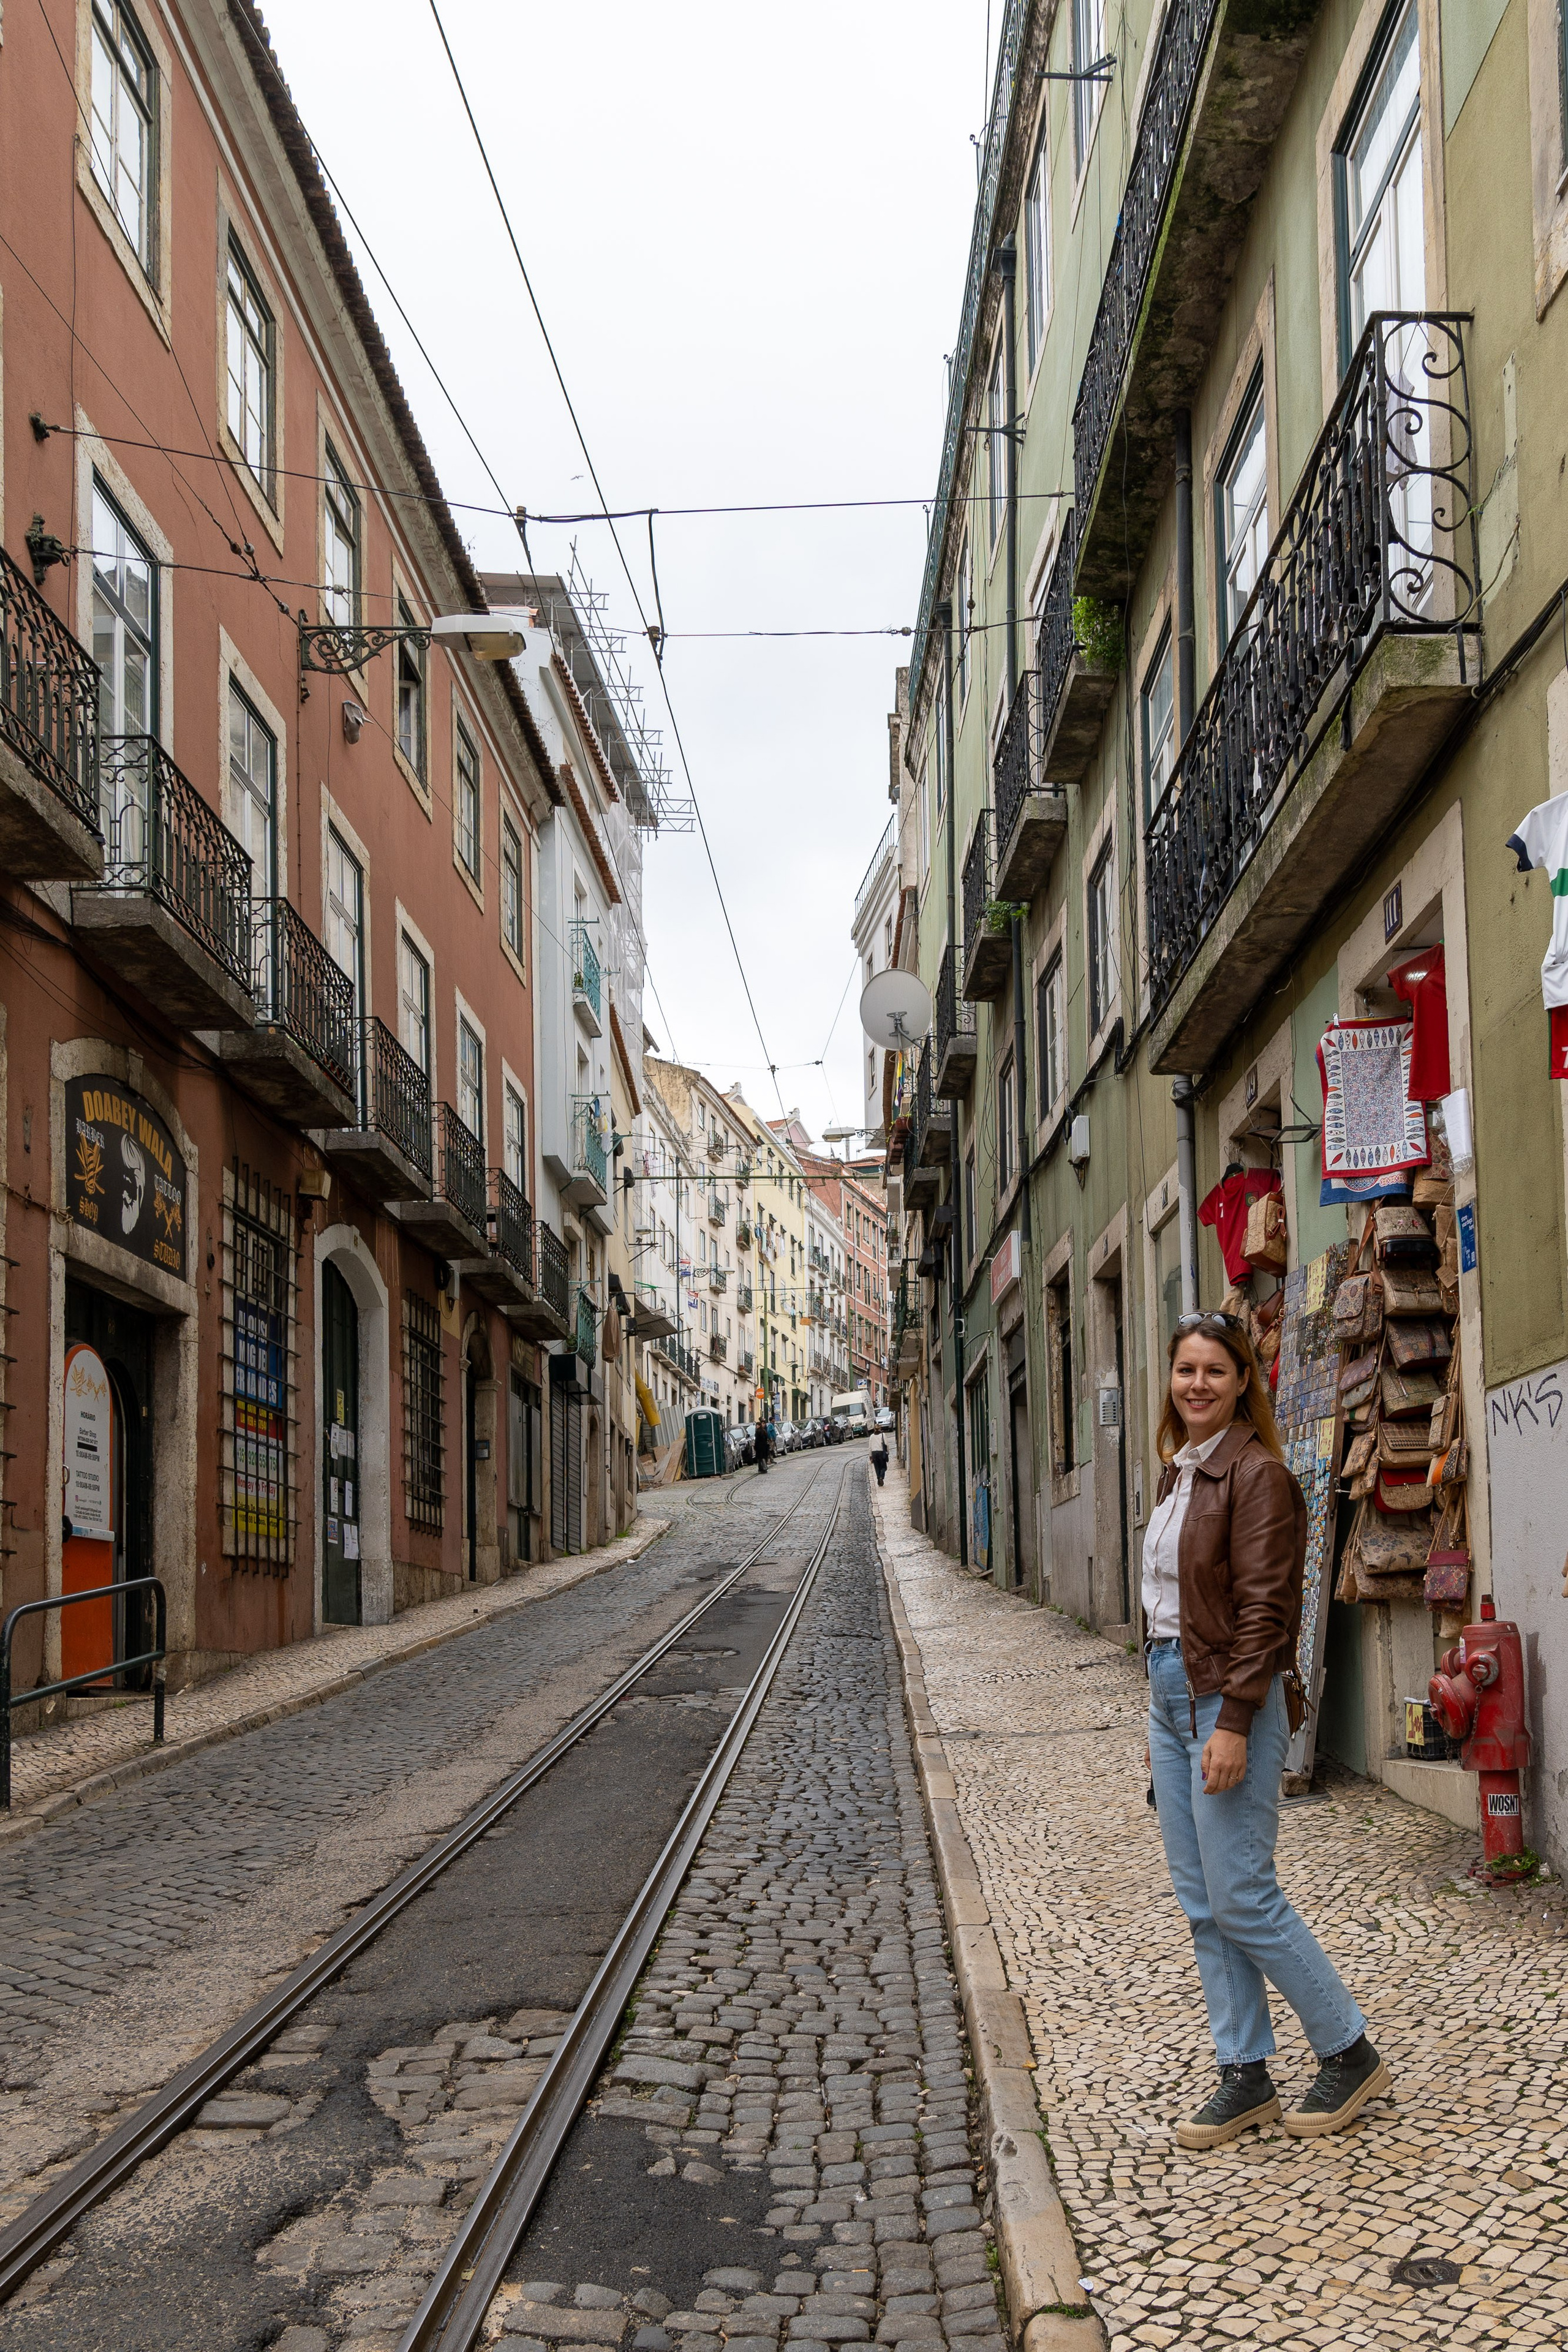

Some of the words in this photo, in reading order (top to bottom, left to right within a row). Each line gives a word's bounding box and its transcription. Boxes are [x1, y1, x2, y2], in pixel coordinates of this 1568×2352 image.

[76, 1117, 105, 1150] BARBER
[82, 1090, 137, 1135] DOABEY
[138, 1113, 173, 1182] WALA
[153, 1238, 181, 1270] STUDIO
[1489, 1795, 1518, 1811] WOSNT
